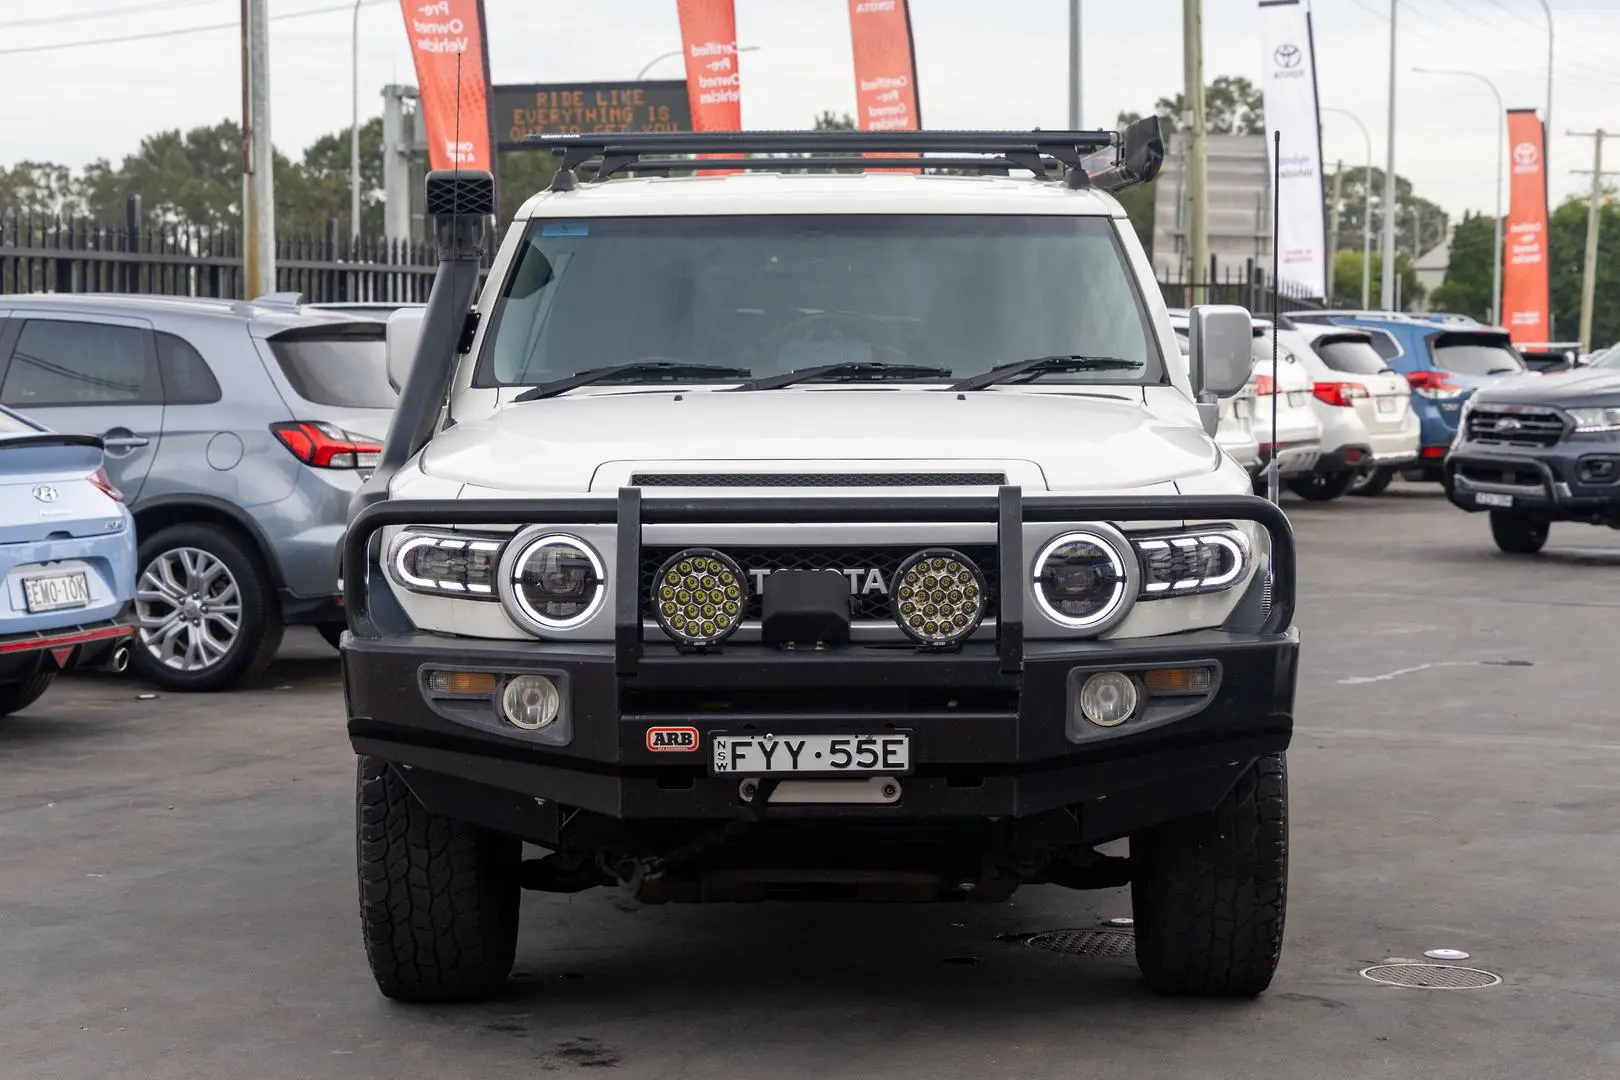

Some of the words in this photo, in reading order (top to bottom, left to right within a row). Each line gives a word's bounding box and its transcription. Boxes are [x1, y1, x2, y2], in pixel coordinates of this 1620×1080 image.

[536, 90, 584, 107] RIDE
[513, 105, 633, 125] EVERYTHING
[648, 104, 670, 122] IS
[749, 568, 888, 595] TTA
[653, 732, 693, 746] ARB
